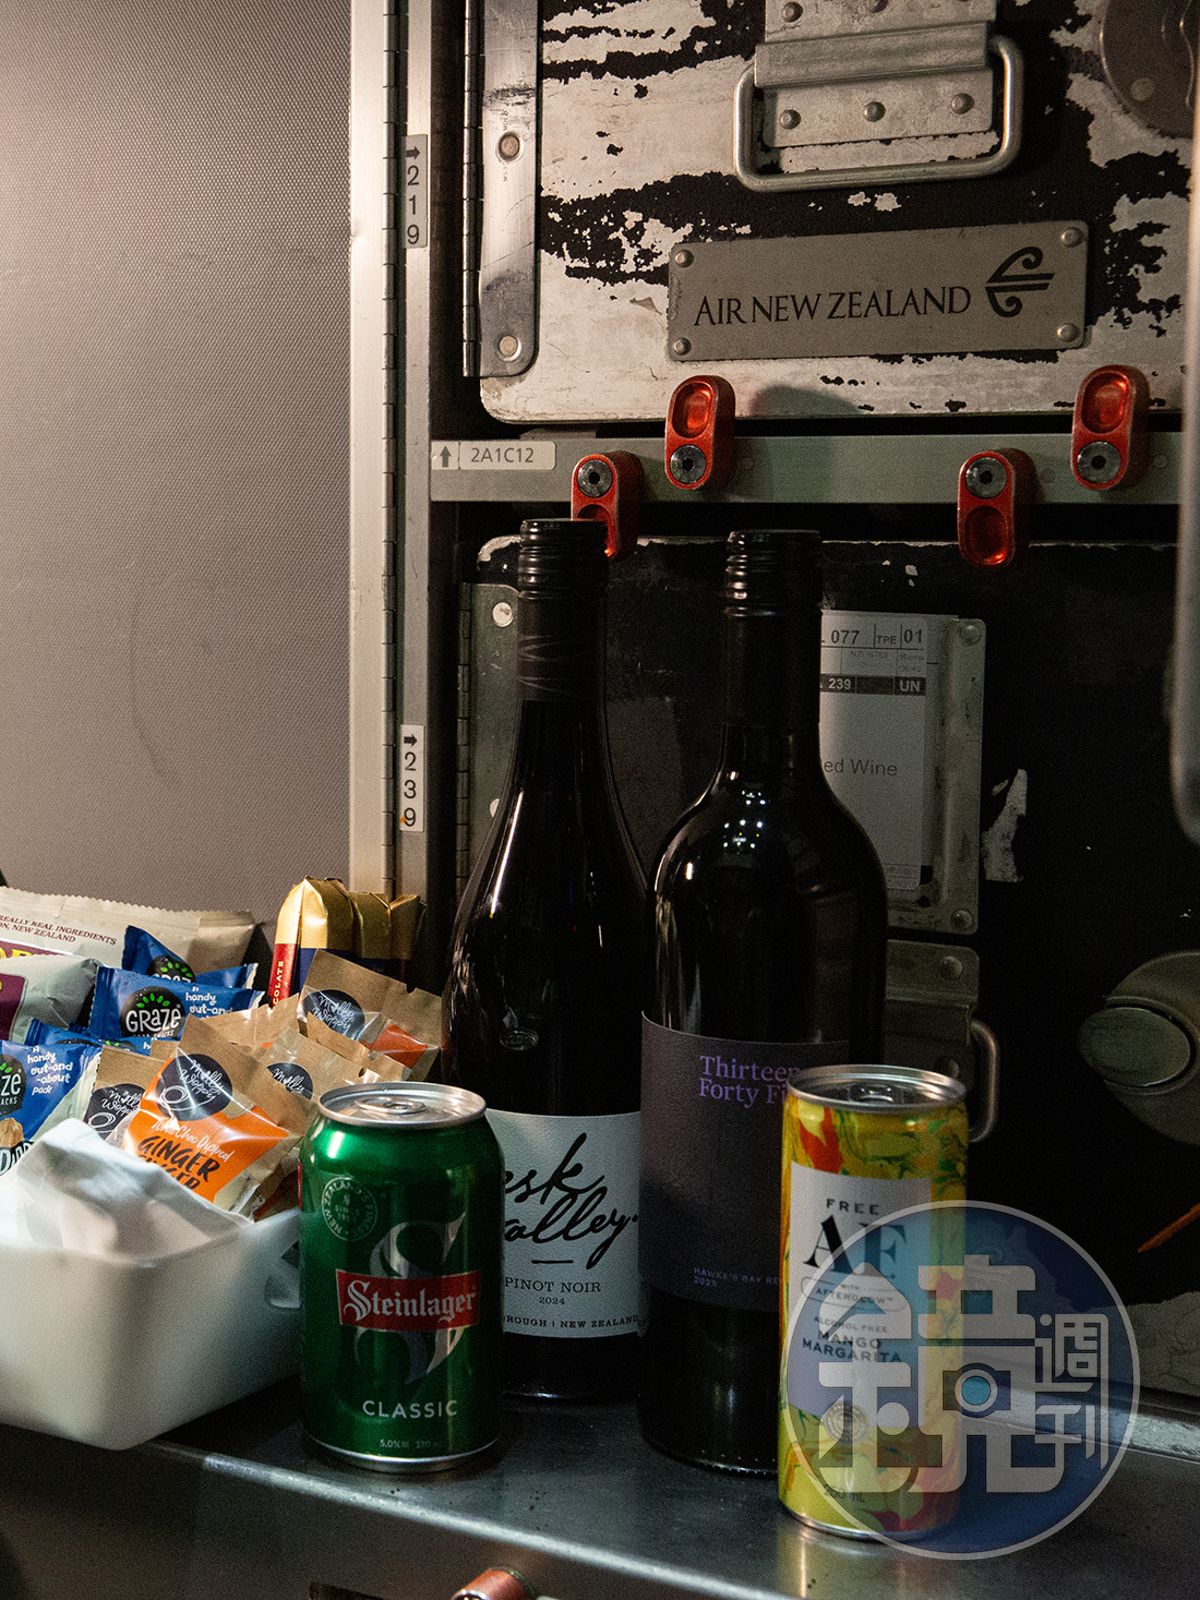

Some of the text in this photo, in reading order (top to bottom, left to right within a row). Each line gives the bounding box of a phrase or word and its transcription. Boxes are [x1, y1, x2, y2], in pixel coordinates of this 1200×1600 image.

[407, 165, 420, 245] 219
[693, 286, 971, 326] AIR NEW ZEALAND
[471, 447, 534, 463] 2A1C12
[830, 628, 922, 645] 077 TPE 01
[828, 677, 920, 692] 239 UN
[823, 758, 898, 777] ed Wine
[404, 751, 417, 827] 239
[12, 923, 33, 934] NEW
[33, 928, 76, 943] ZEALAND
[30, 919, 54, 930] REAL
[55, 923, 118, 946] INGREDIENTS
[185, 991, 216, 1006] handy
[27, 1052, 56, 1064] handy
[30, 1062, 73, 1075] out-and
[32, 1085, 53, 1096] pack
[700, 1078, 787, 1109] Forty Fi
[138, 1136, 220, 1182] GINGER
[826, 1198, 879, 1216] FREE
[505, 1277, 601, 1293] PINOT NOIR
[344, 1279, 477, 1323] Steinlager
[538, 1297, 566, 1305] 2024
[504, 1315, 638, 1328] ROUGH NEW ZEALAND
[818, 1330, 882, 1349] MANGO
[802, 1337, 901, 1364] MARGARITA
[362, 1400, 458, 1419] CLASSIC
